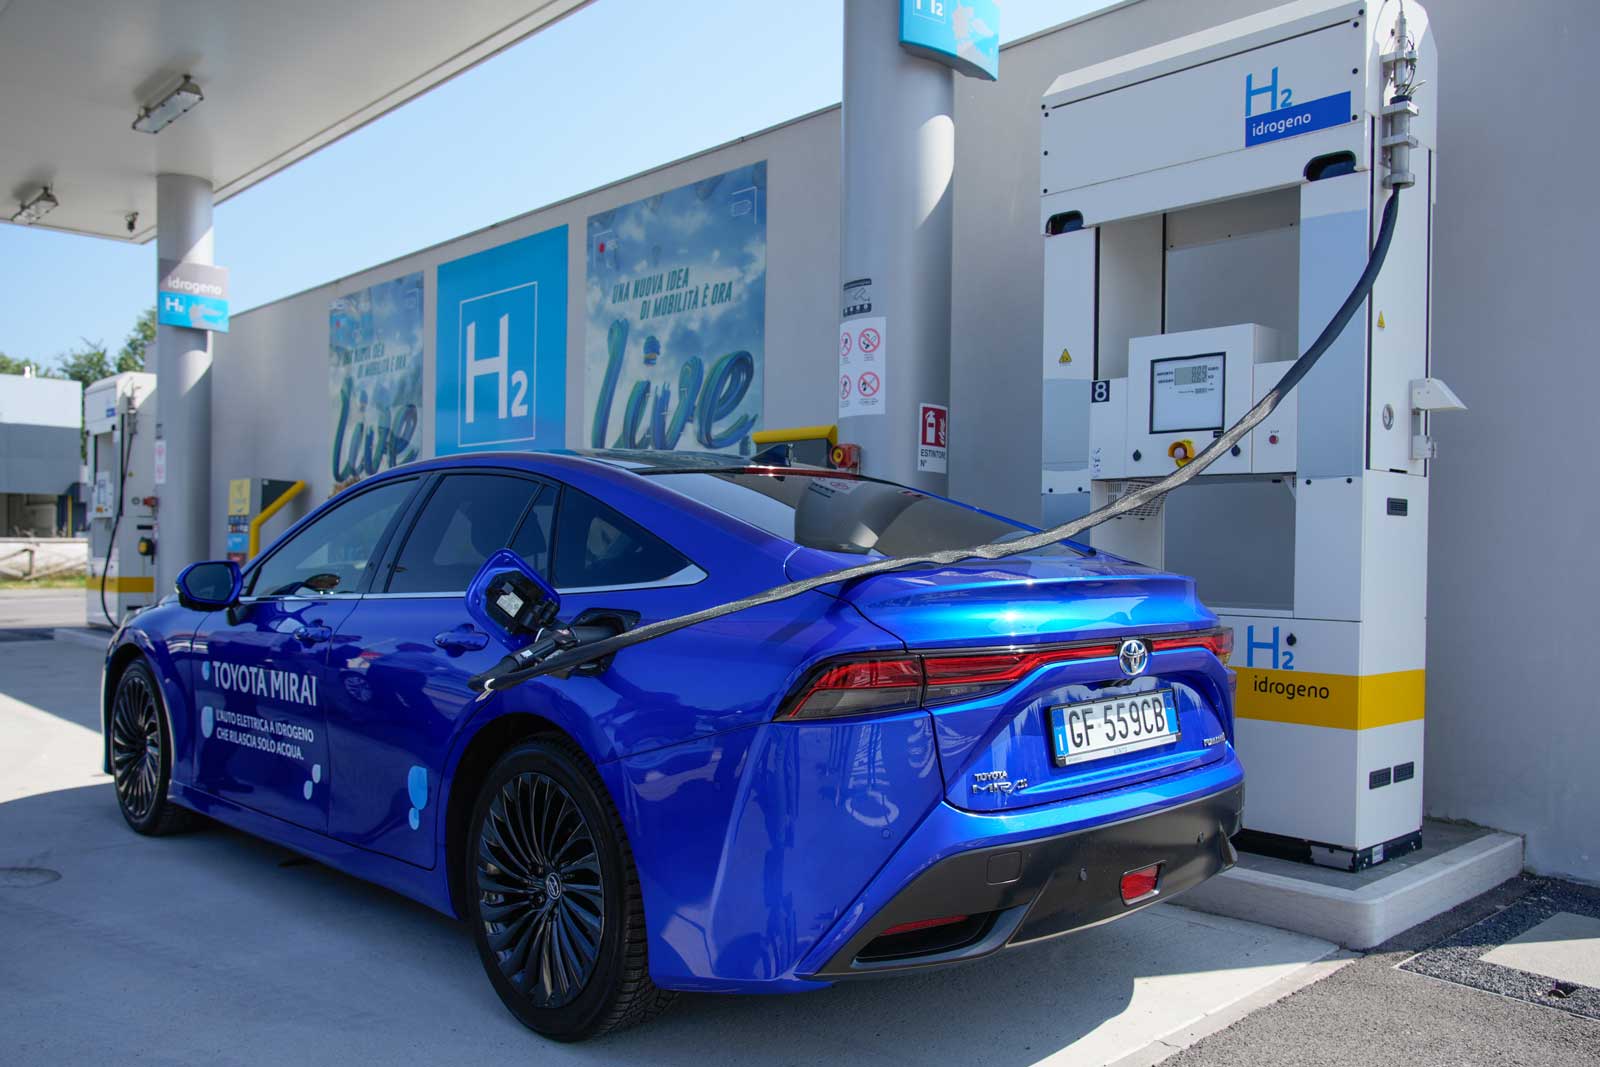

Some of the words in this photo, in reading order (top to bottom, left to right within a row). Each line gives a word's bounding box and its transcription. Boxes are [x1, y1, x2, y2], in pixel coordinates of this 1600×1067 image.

[1245, 66, 1293, 117] H2
[1252, 113, 1312, 137] idrogeno
[167, 275, 223, 295] idrogeno
[612, 281, 630, 305] UNA
[632, 273, 663, 300] NUOVA
[666, 267, 689, 292] IDEA
[639, 300, 649, 320] DI
[652, 285, 698, 319] MOBILITÀ
[701, 282, 710, 308] È
[711, 280, 733, 305] ORA
[465, 313, 528, 424] H2
[1094, 381, 1107, 402] 8
[1247, 624, 1294, 670] H2
[212, 661, 268, 697] TOYOTA
[270, 669, 317, 707] MIRAI
[1253, 675, 1330, 700] idrogeno
[216, 709, 236, 725] L'AUTO
[236, 713, 269, 733] ELETTRICA
[269, 722, 275, 734] A
[275, 722, 314, 743] IDROGENO
[216, 727, 229, 741] CHE
[229, 730, 257, 749] RILASCIA
[257, 737, 276, 753] SOLO
[1068, 707, 1095, 749] GF
[1103, 696, 1165, 742] 559CB
[974, 770, 1008, 782] TOYOTA
